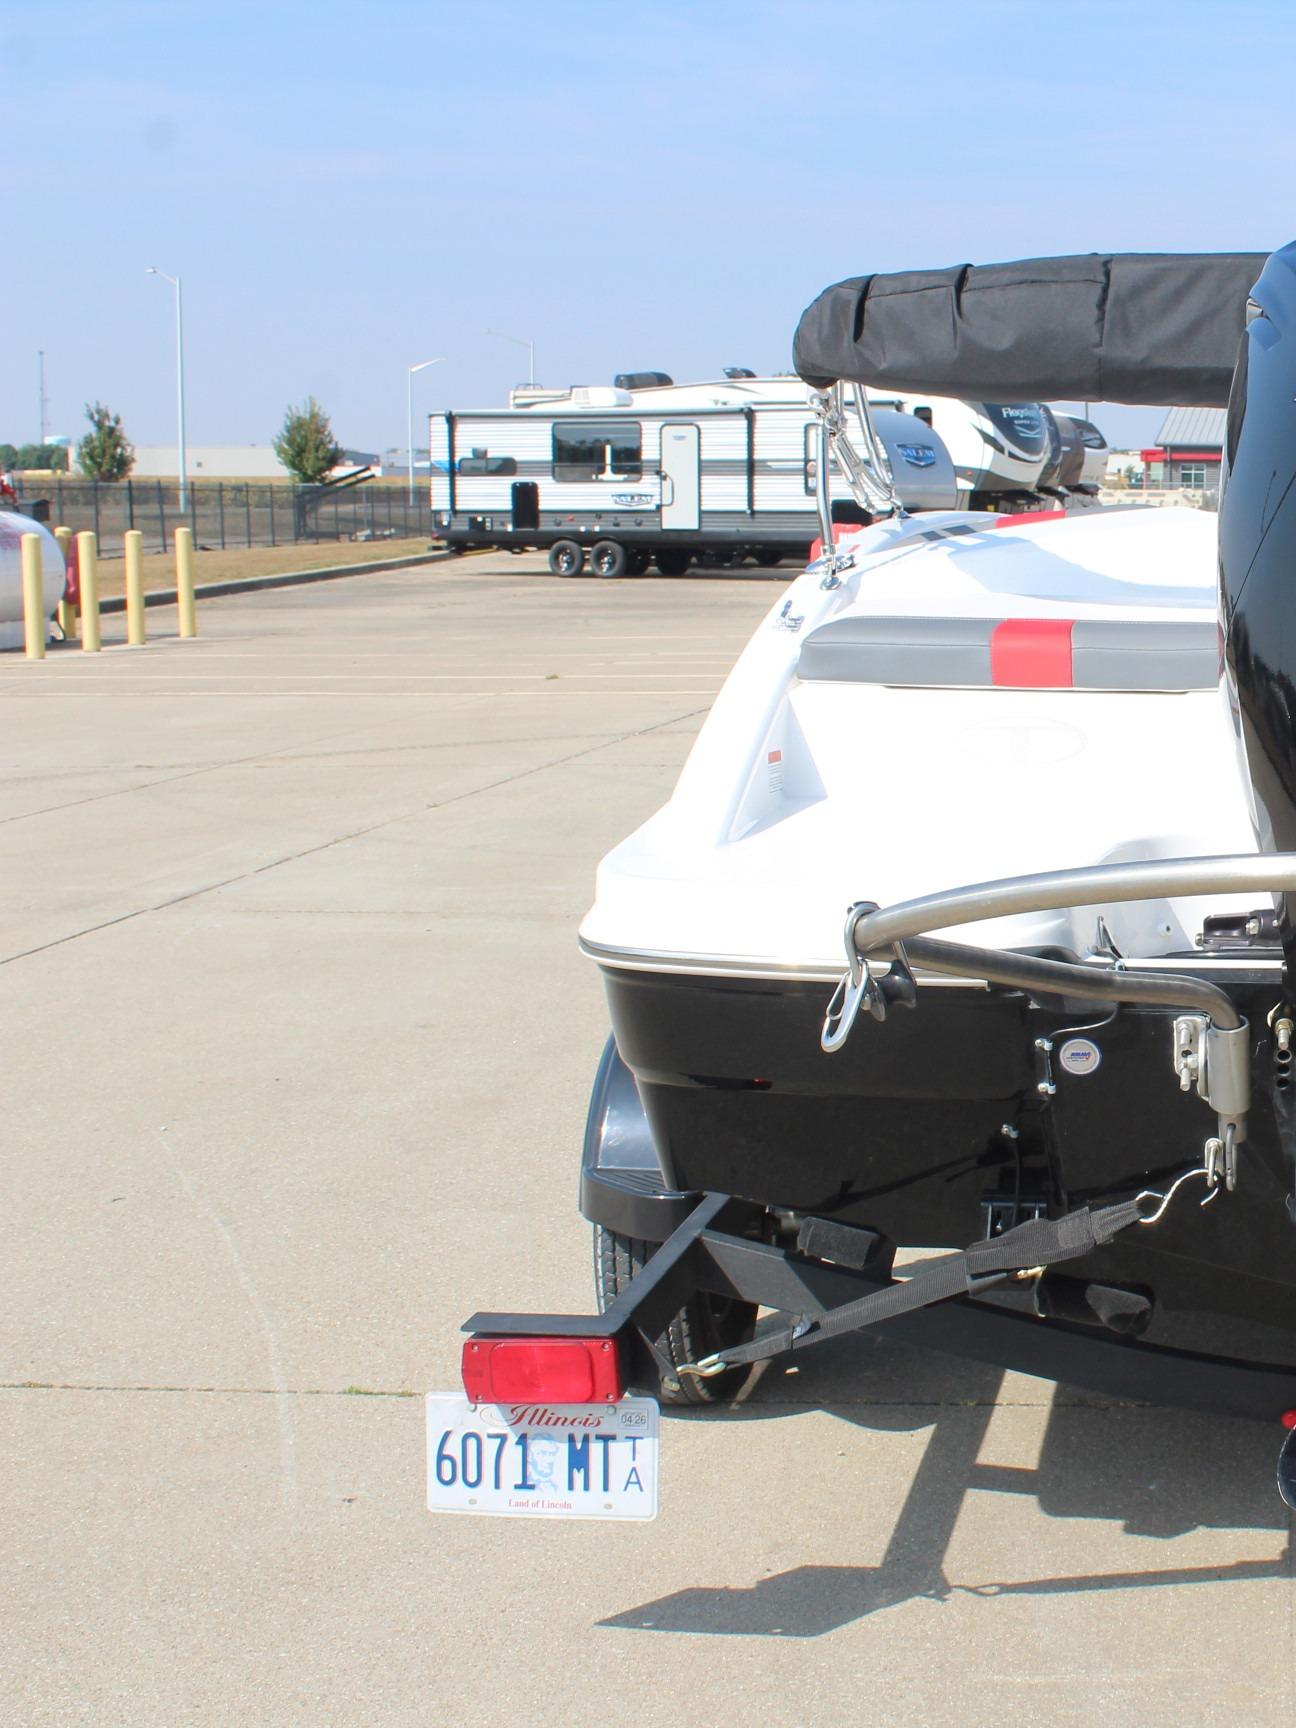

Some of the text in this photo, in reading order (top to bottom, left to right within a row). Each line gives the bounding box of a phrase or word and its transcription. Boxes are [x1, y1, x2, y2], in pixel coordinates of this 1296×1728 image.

[506, 1404, 604, 1428] Illinois
[436, 1431, 536, 1490] 6071
[567, 1433, 617, 1492] MT
[508, 1498, 573, 1510] Land of Lincoln
